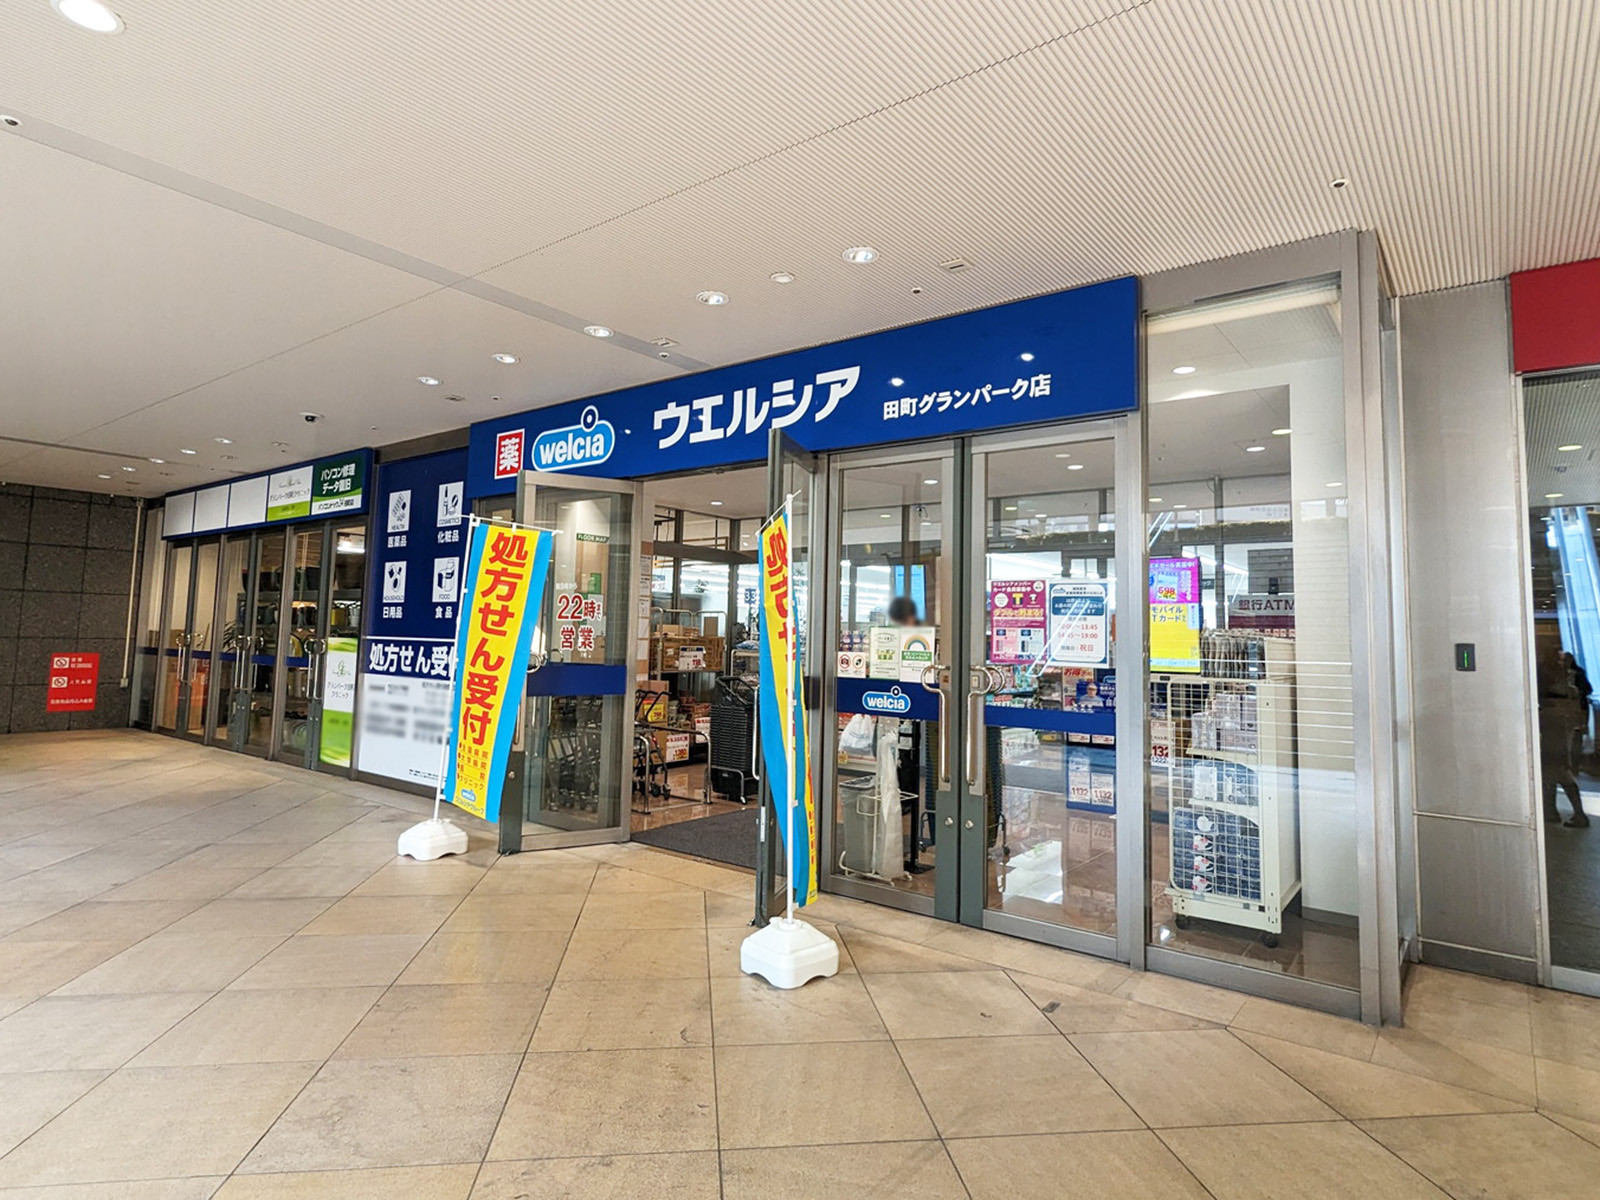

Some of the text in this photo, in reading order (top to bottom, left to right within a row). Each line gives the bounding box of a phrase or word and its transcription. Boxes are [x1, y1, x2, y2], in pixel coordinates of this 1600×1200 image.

[653, 365, 861, 449] ウエルシア
[883, 374, 1052, 421] 田町グランパーク店
[499, 437, 520, 471] 薬
[539, 432, 605, 465] welcia
[437, 530, 459, 544] 化粧品
[382, 606, 403, 619] 日用品
[435, 605, 453, 619] 食品
[1152, 605, 1183, 614] モバイル
[1238, 598, 1295, 611] 銀行ATM
[462, 531, 529, 747] 処方せん受付
[560, 626, 594, 650] 営業
[866, 696, 906, 710] welcia
